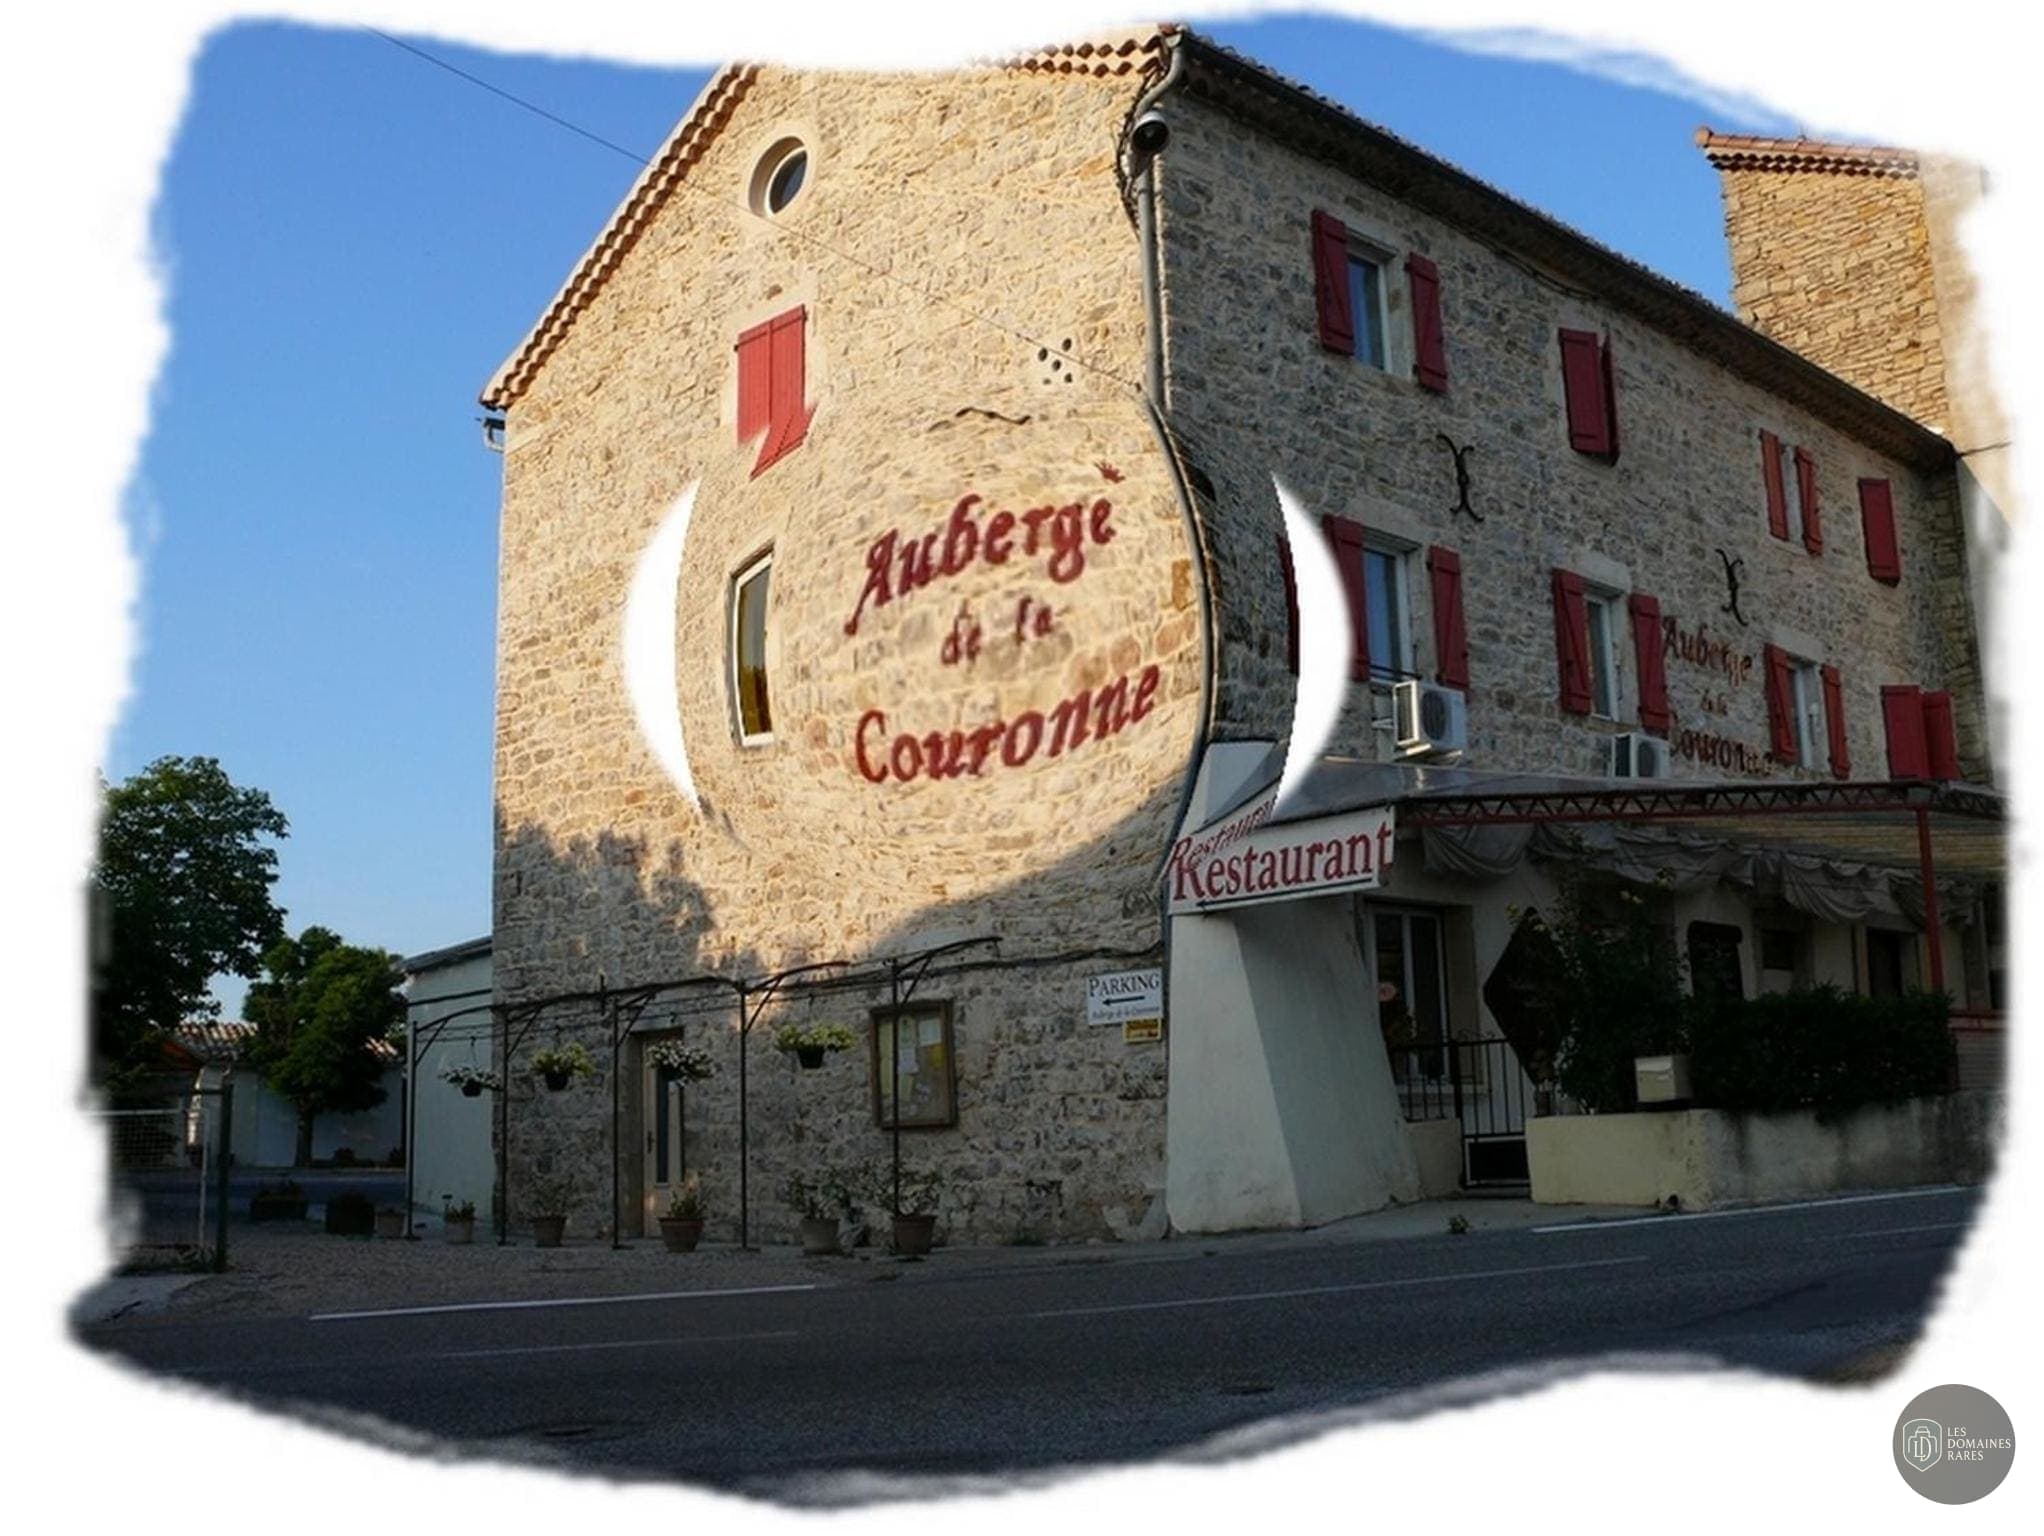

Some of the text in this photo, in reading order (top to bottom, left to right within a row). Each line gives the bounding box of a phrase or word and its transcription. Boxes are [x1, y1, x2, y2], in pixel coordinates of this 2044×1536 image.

[844, 493, 1117, 637] Auberge
[941, 595, 1055, 666] de la
[1661, 615, 1751, 688] Auberge
[855, 663, 1161, 785] Couronne
[1172, 821, 1393, 900] Restaurant
[1089, 973, 1160, 997] PARKING
